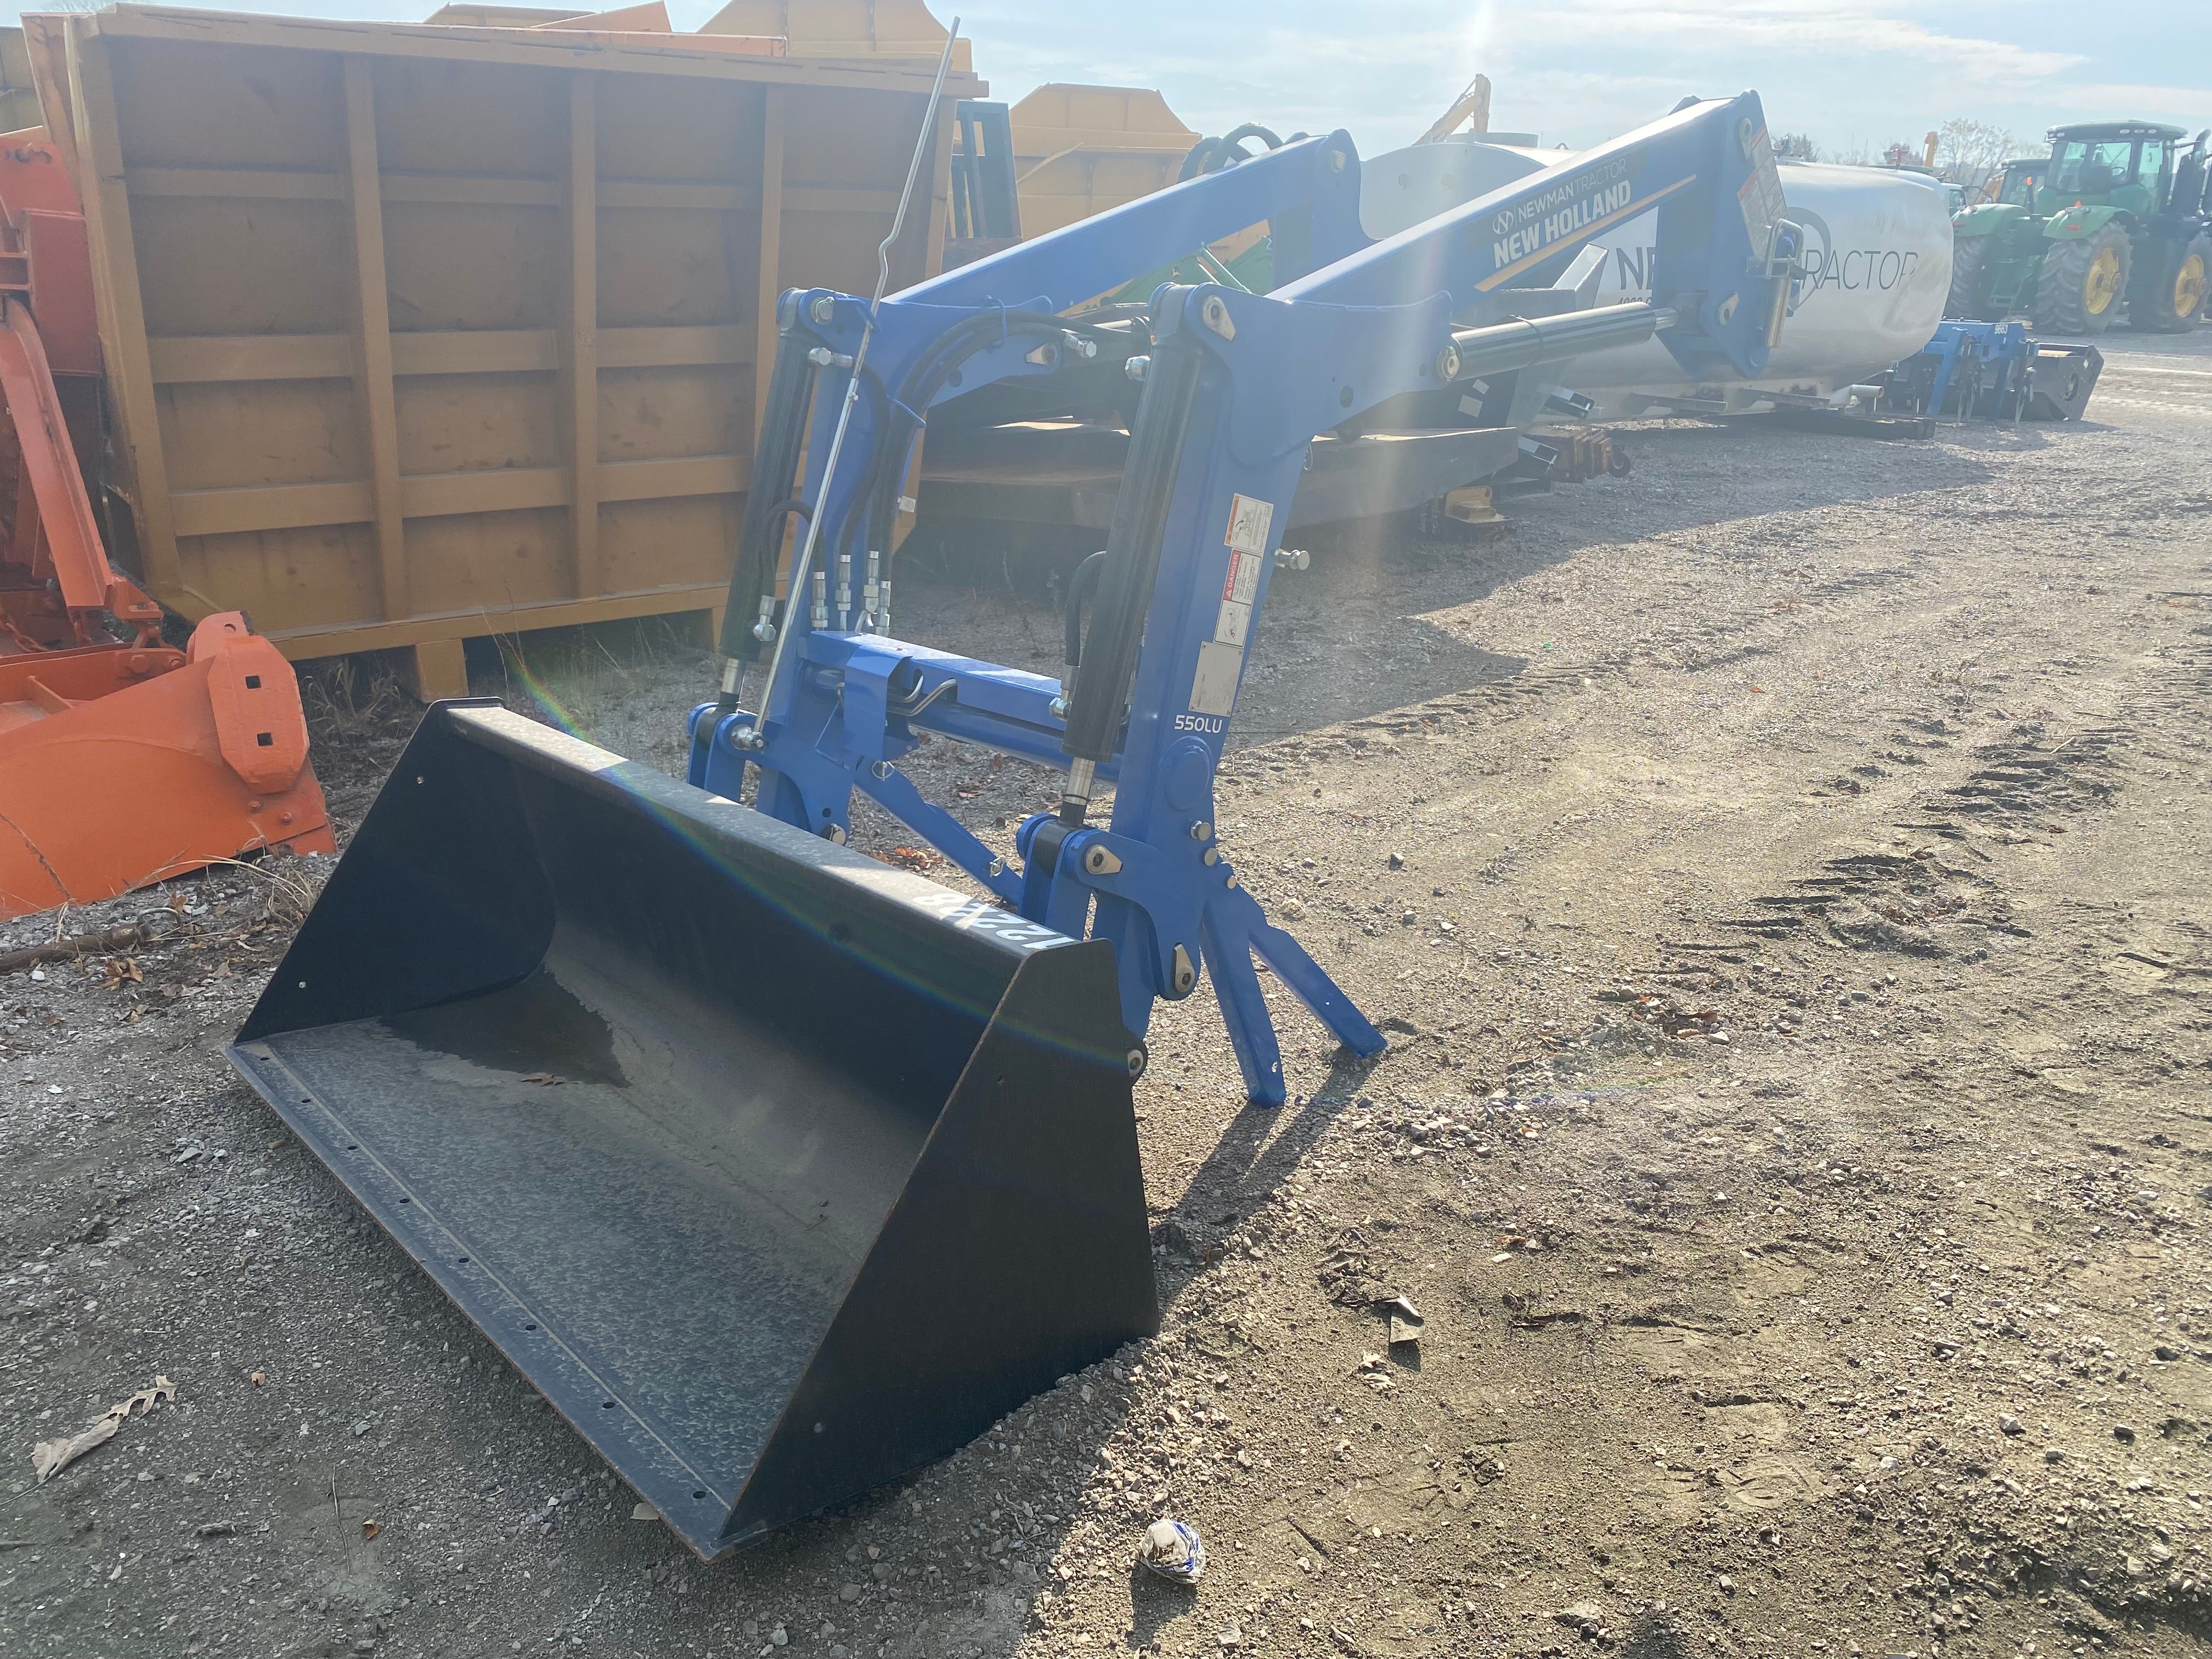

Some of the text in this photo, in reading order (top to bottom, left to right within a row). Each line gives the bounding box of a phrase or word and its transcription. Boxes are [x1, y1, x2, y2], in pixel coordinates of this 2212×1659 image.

[1493, 179, 1632, 268] NEW HOLLAND
[1802, 249, 1918, 290] RACTOR
[1228, 554, 1239, 588] DANGER
[1174, 714, 1223, 733] 550LU
[912, 893, 1075, 950] 12228
